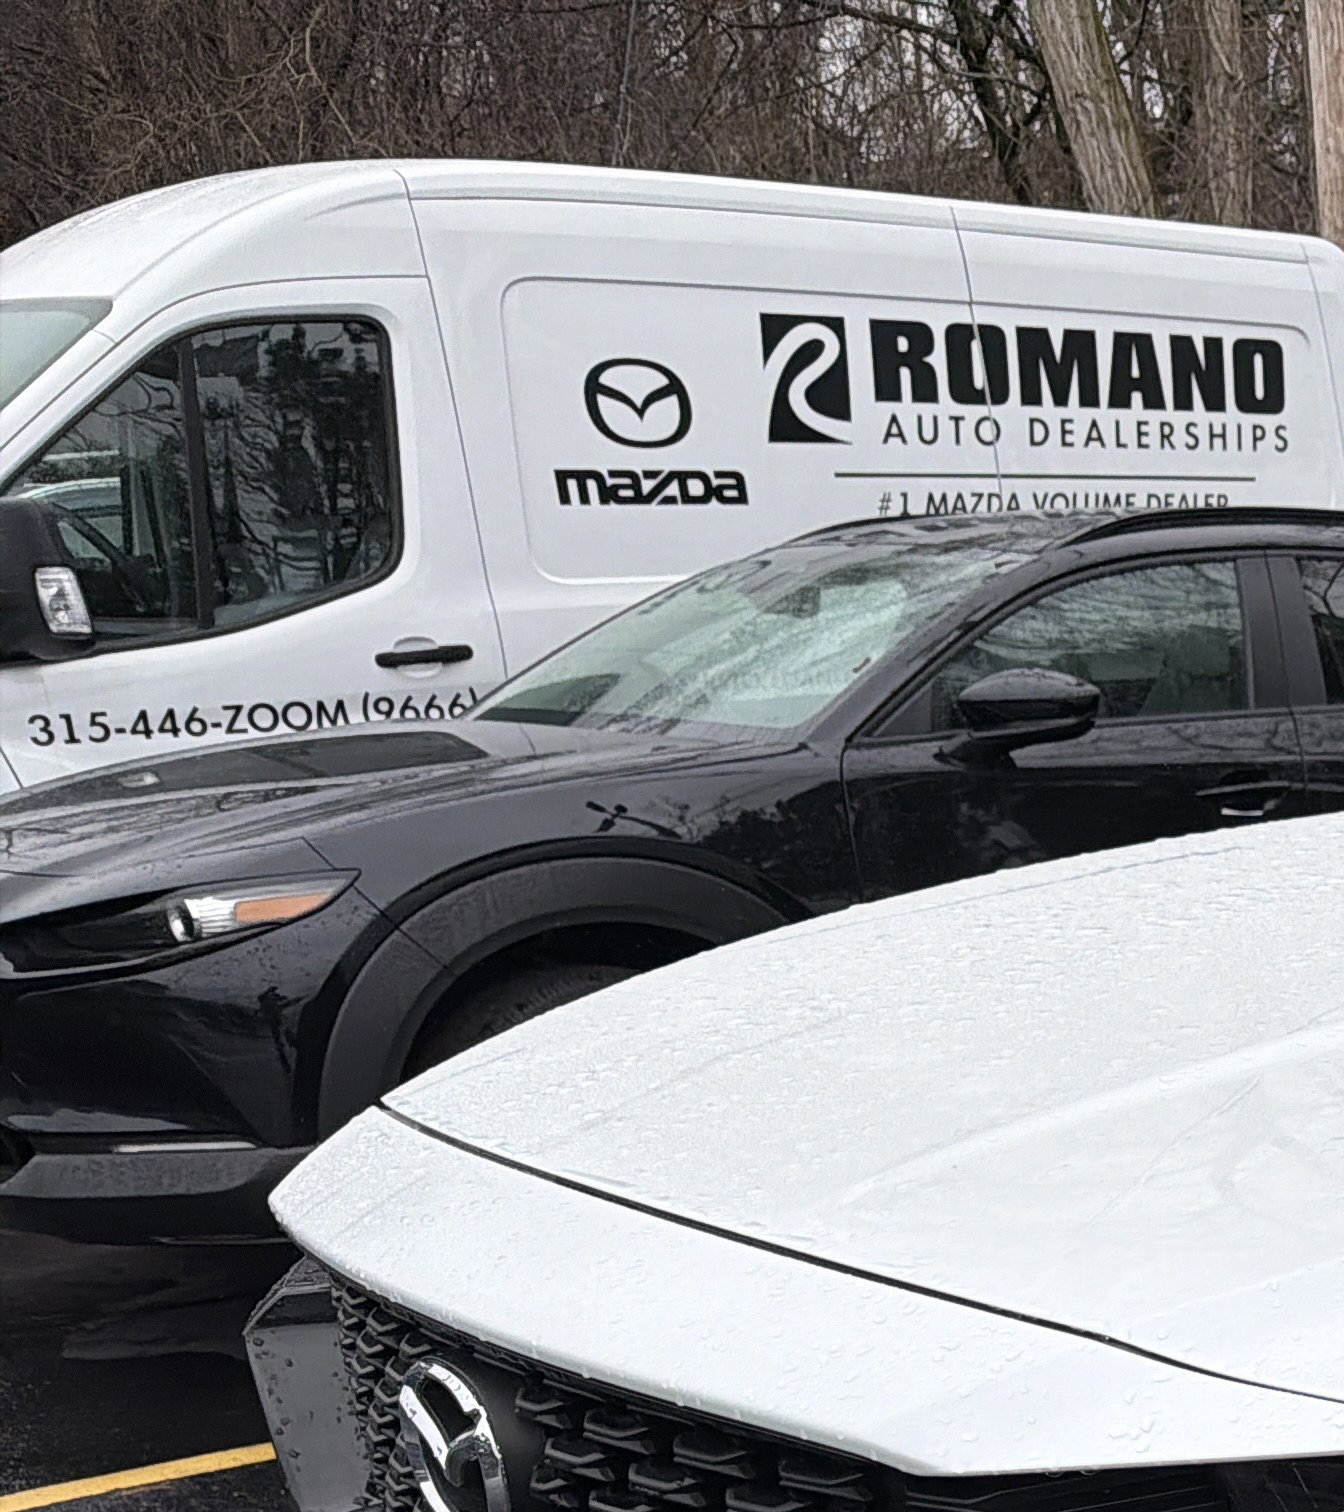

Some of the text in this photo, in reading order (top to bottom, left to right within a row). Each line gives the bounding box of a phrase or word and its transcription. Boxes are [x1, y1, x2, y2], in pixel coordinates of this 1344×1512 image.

[869, 318, 1286, 414] ROMANO
[882, 413, 1291, 454] AUTO DEALERSHIPS
[925, 492, 1021, 515] MAZDA
[1033, 492, 1137, 510] VOLUME
[28, 699, 350, 747] 315-446-ZOOM
